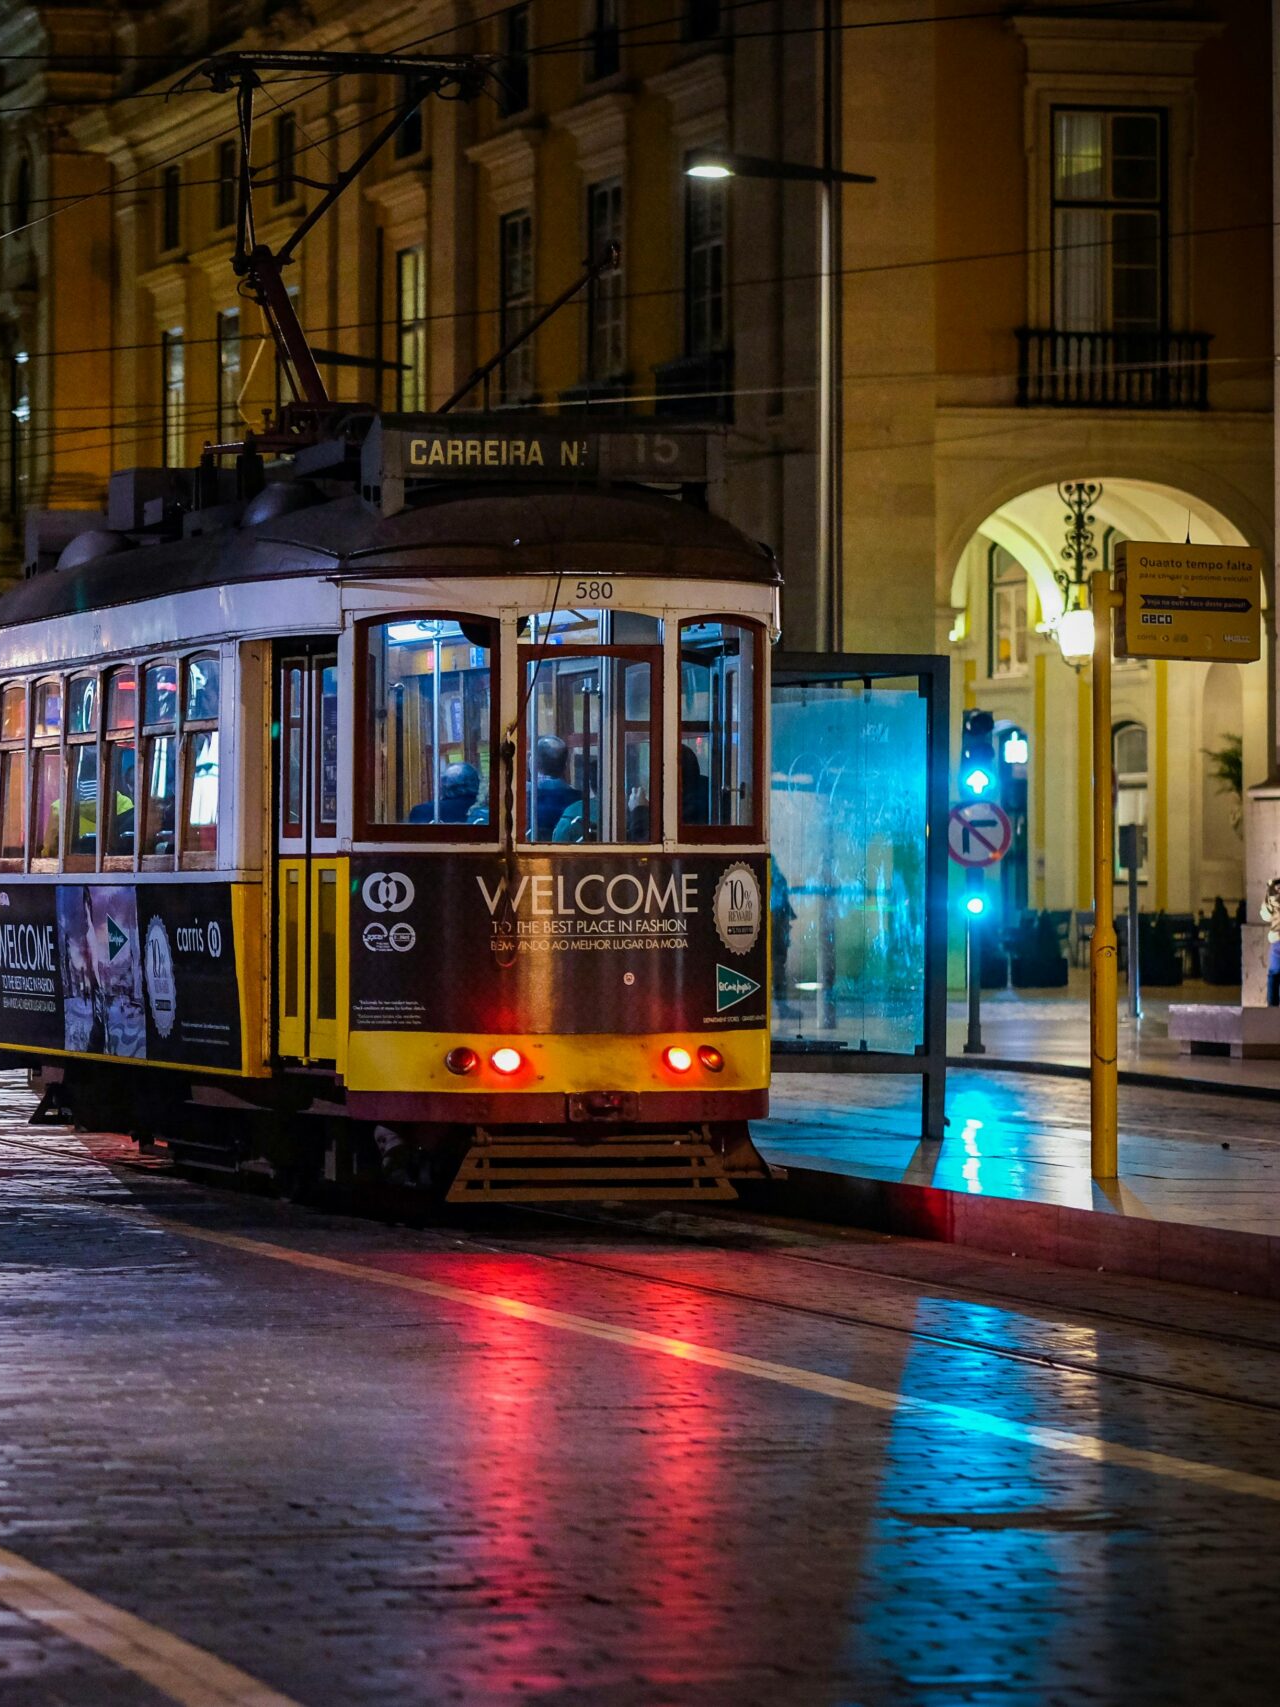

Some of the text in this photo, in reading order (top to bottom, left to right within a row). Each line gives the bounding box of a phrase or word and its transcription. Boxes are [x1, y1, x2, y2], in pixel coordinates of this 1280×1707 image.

[410, 439, 544, 466] CARREIRA
[632, 433, 679, 464] 15
[1140, 557, 1253, 571] Quanto tempo falta
[576, 581, 613, 600] 580
[476, 873, 699, 915] WELCOME
[177, 918, 204, 952] carris
[492, 918, 687, 934] TO THE BEST PLACE IN FASHION
[552, 940, 569, 950] AO
[571, 939, 611, 950] MELHOR
[613, 939, 644, 950] LUGAR
[645, 938, 659, 949] DA
[661, 938, 689, 949] MODA
